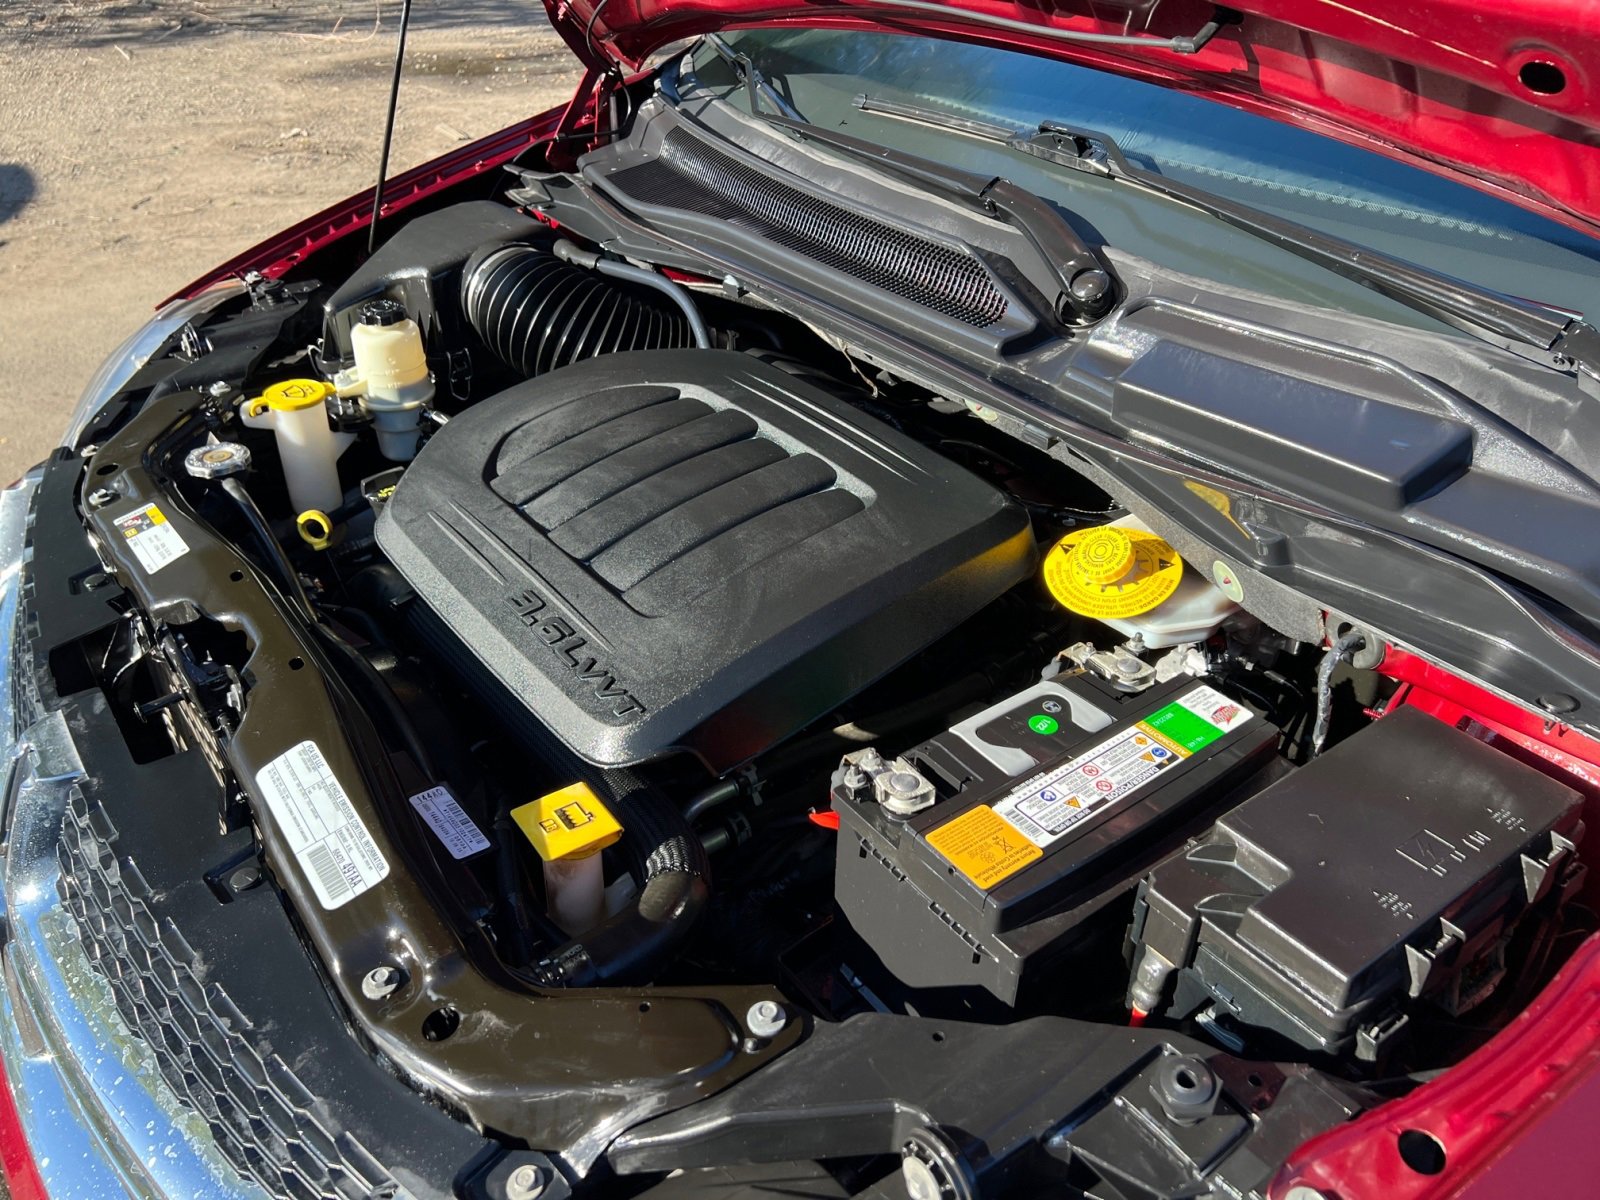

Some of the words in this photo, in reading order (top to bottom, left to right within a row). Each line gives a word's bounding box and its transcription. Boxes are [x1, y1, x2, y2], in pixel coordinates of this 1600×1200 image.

[305, 743, 315, 754] FCA
[310, 751, 319, 761] US
[314, 758, 324, 769] LLC
[1103, 765, 1160, 801] DANGER/POISON
[327, 780, 343, 801] VEHICLE
[337, 797, 355, 821] EMISSION
[349, 817, 367, 841] CONTROL
[361, 838, 386, 872] INFORMATION
[339, 860, 363, 889] 491AA
